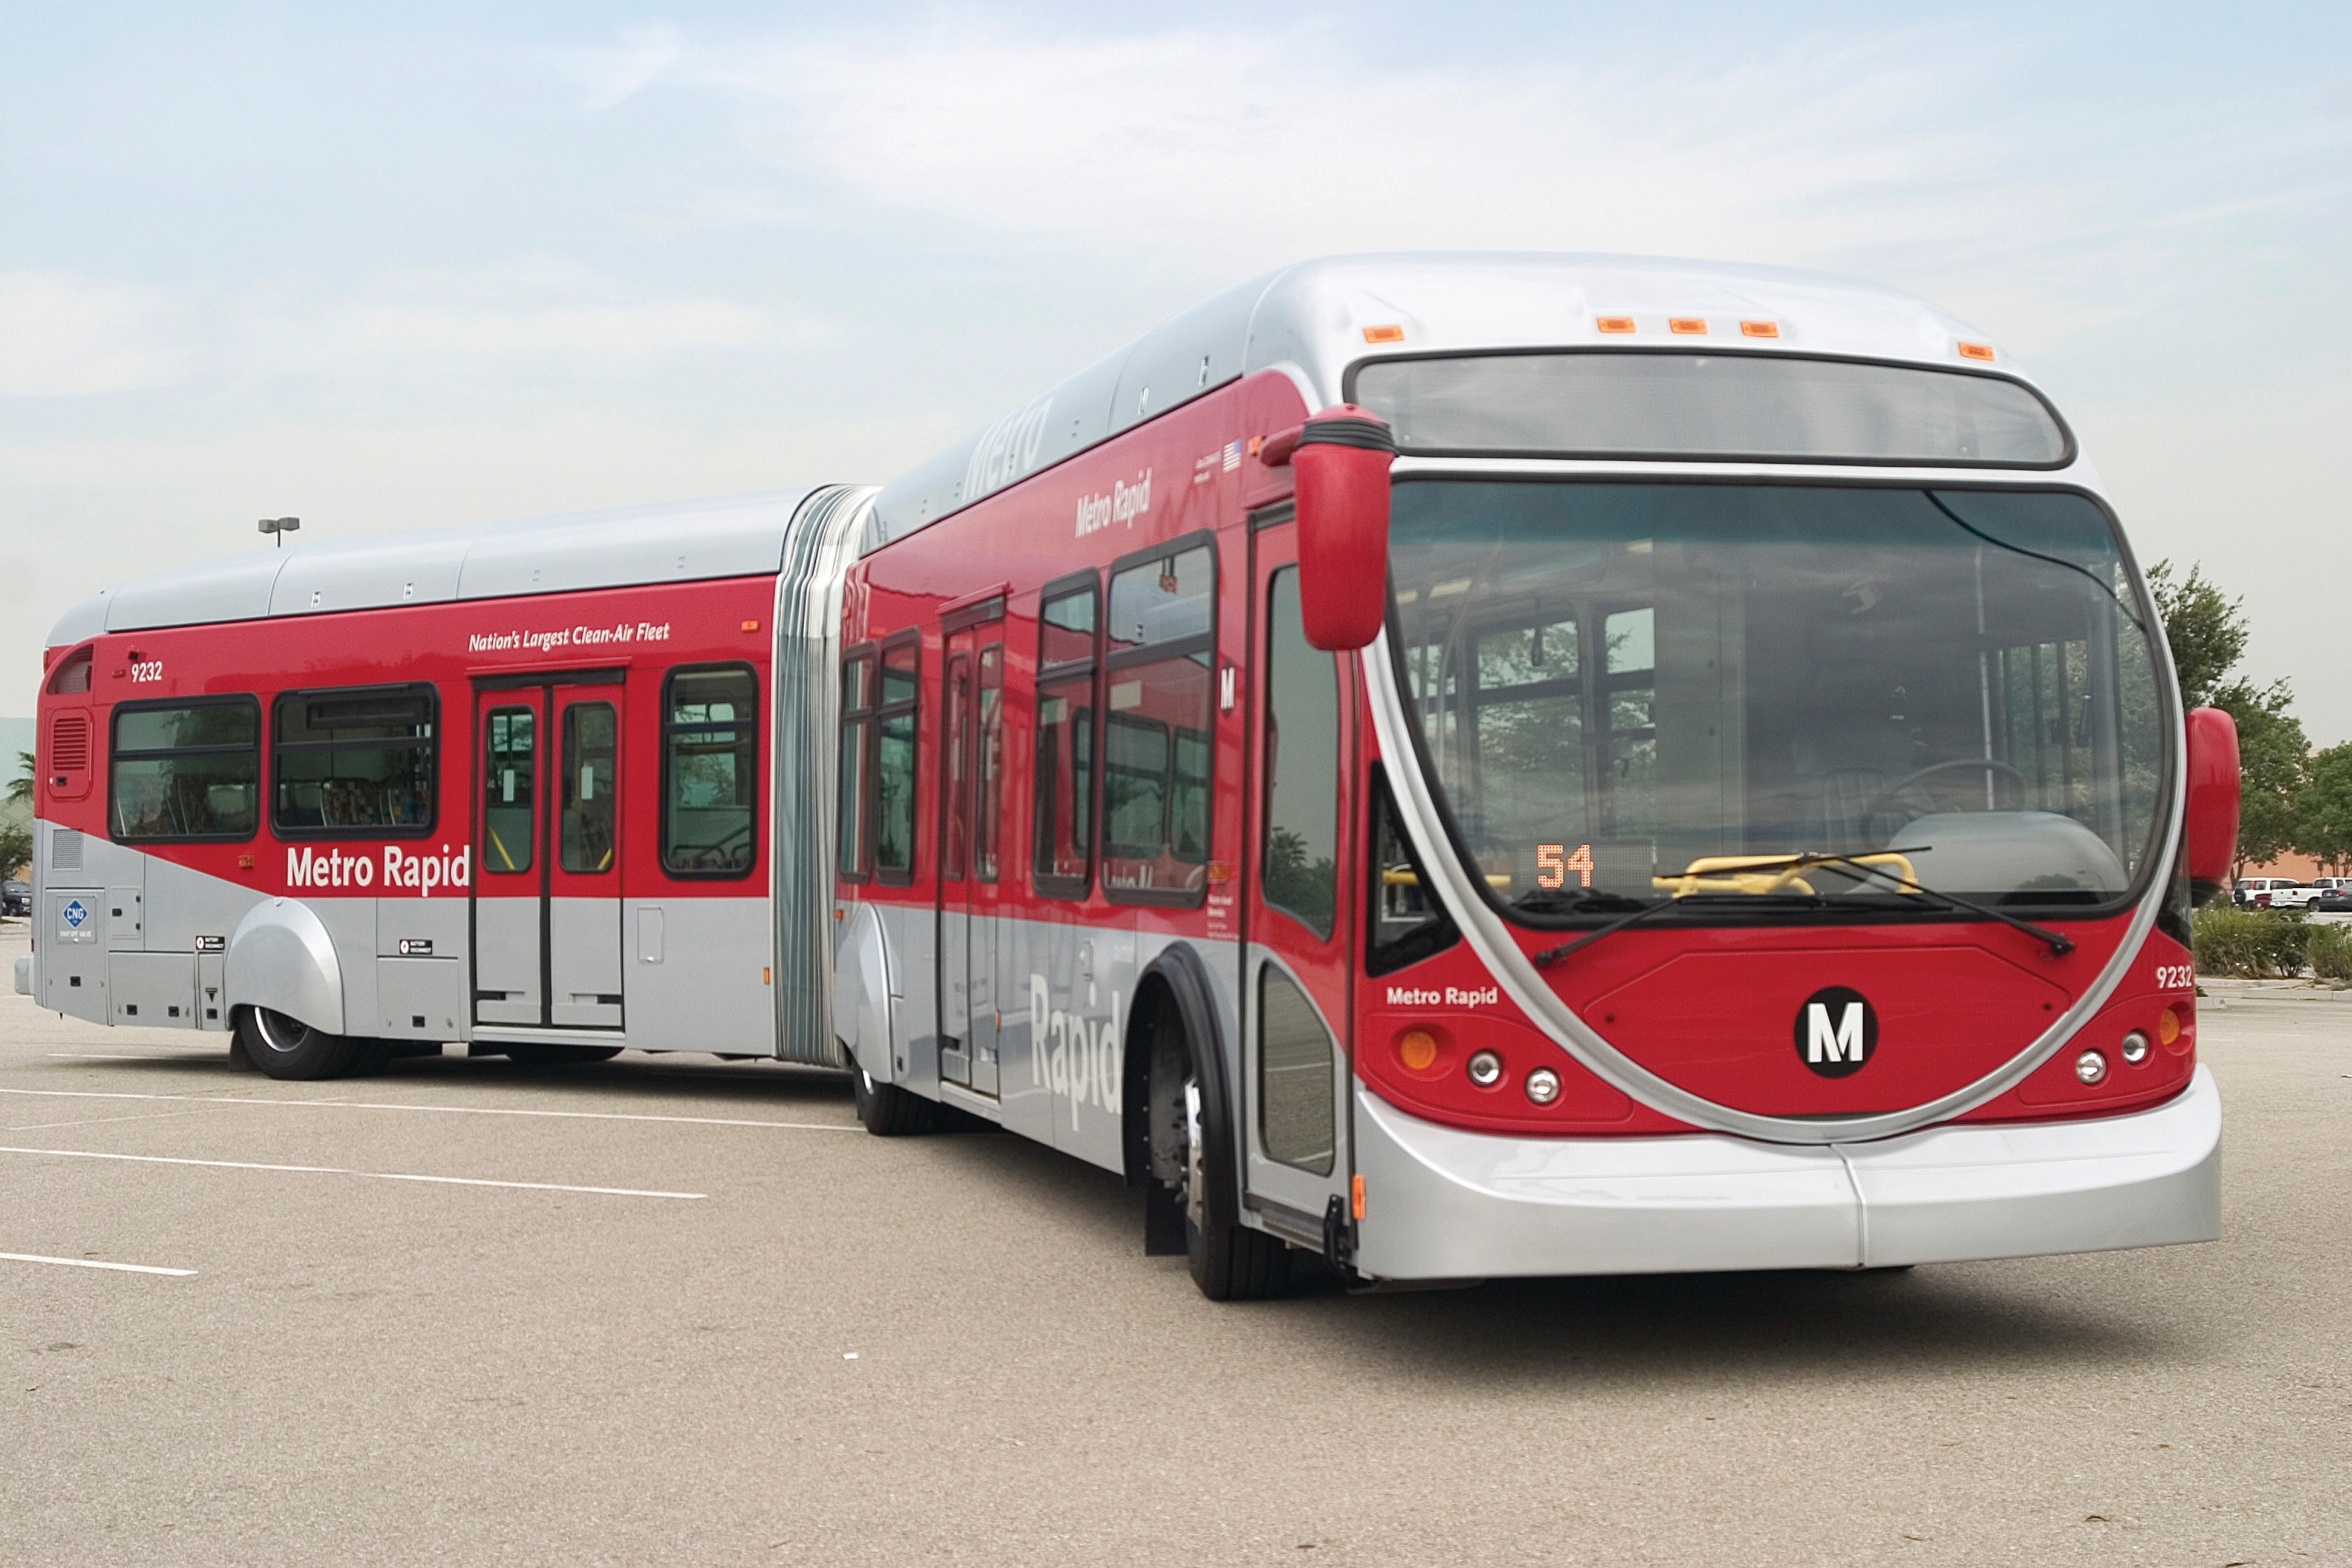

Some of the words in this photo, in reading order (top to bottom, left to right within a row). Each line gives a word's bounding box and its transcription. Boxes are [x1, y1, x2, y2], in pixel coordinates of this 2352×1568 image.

[1075, 491, 1112, 538] Metro
[1112, 466, 1152, 530] Rapid
[523, 628, 570, 652] Largest
[573, 624, 633, 645] Clean-Air
[636, 622, 670, 641] Fleet
[132, 661, 162, 683] 9232
[1220, 667, 1235, 710] M
[287, 846, 374, 887] Metro
[384, 844, 469, 897] Rapid
[1537, 844, 1594, 888] 54
[67, 907, 84, 920] CNG
[1387, 986, 1441, 1004] Metro
[1445, 986, 1498, 1008] Rapid
[2157, 965, 2193, 989] 9232
[1030, 974, 1122, 1133] Rapid
[1808, 1001, 1864, 1063] M
